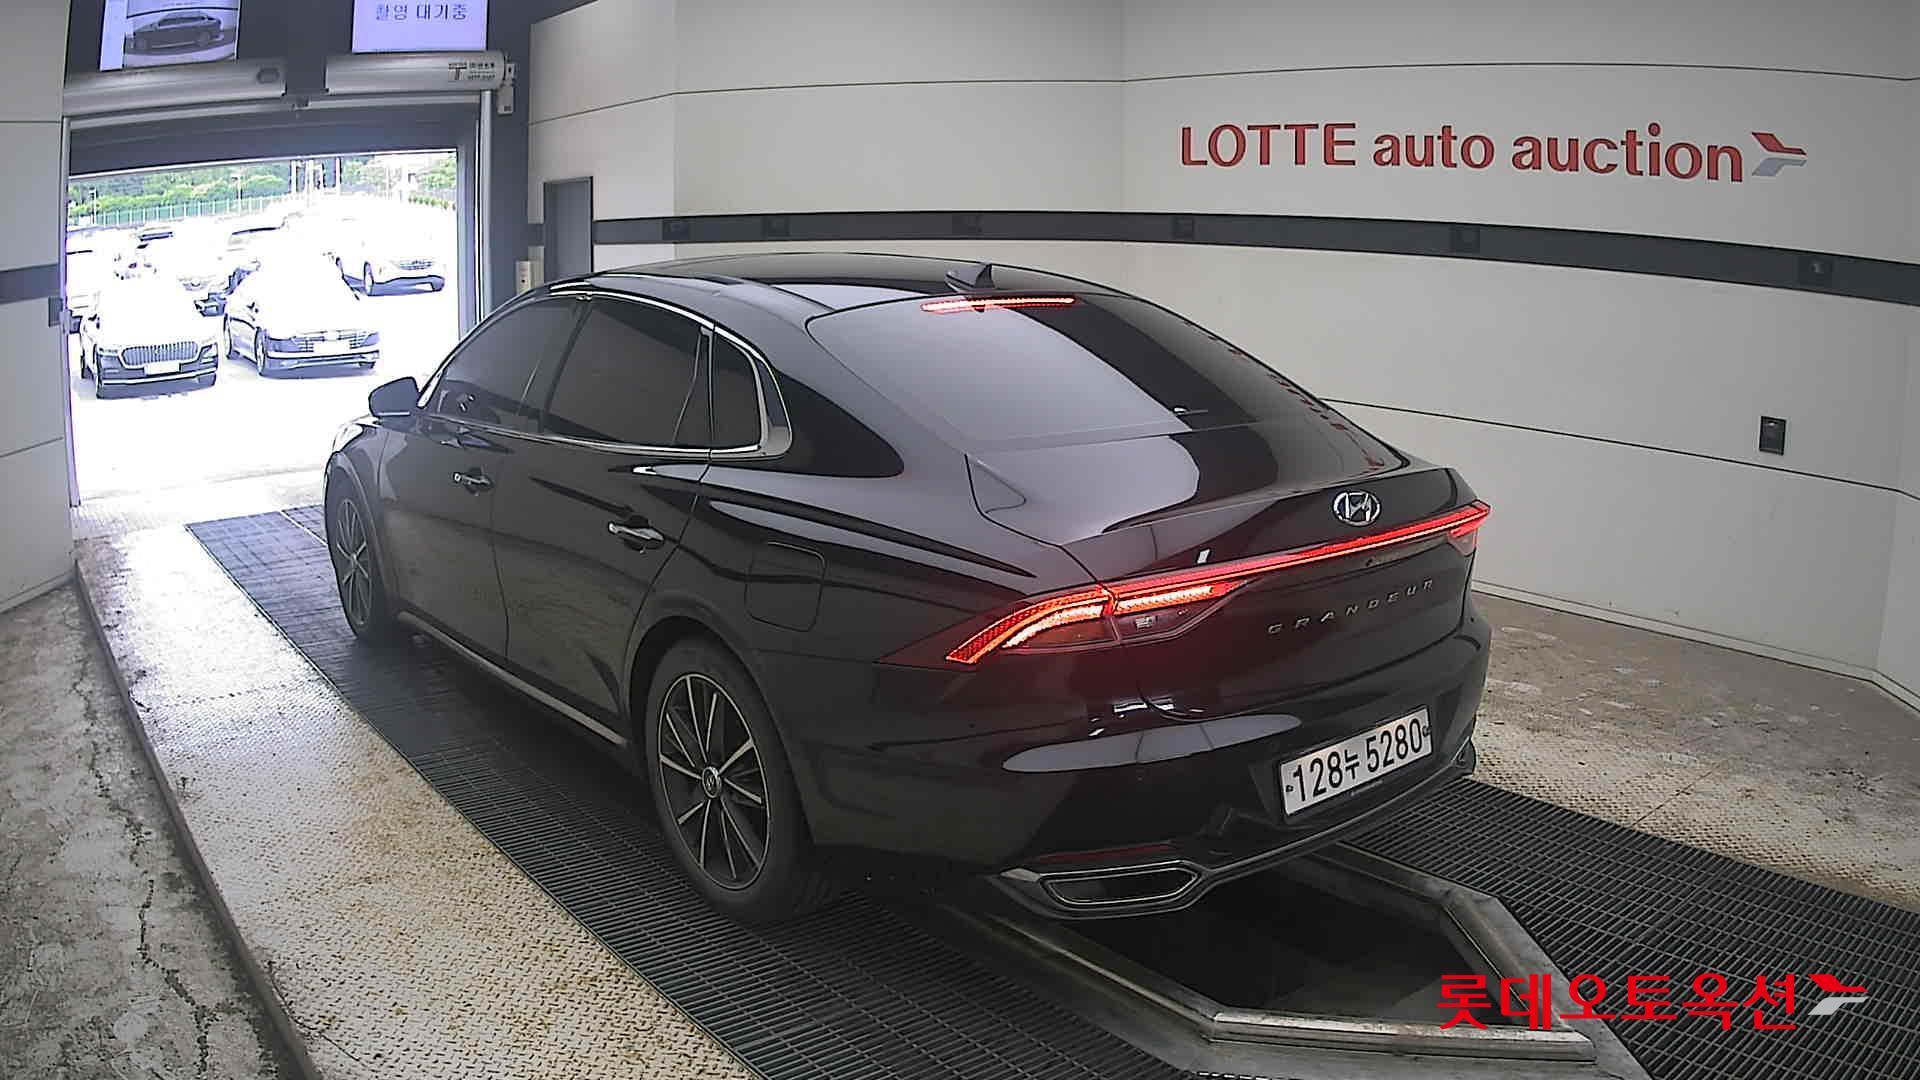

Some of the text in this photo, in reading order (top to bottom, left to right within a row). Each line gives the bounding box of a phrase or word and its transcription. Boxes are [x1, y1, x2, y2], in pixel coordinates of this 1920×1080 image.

[416, 4, 467, 21] 대기중
[1181, 122, 1744, 182] LOTTE auto auction
[1267, 577, 1433, 633] GRANDEUR
[1293, 718, 1422, 802] 128누 5280
